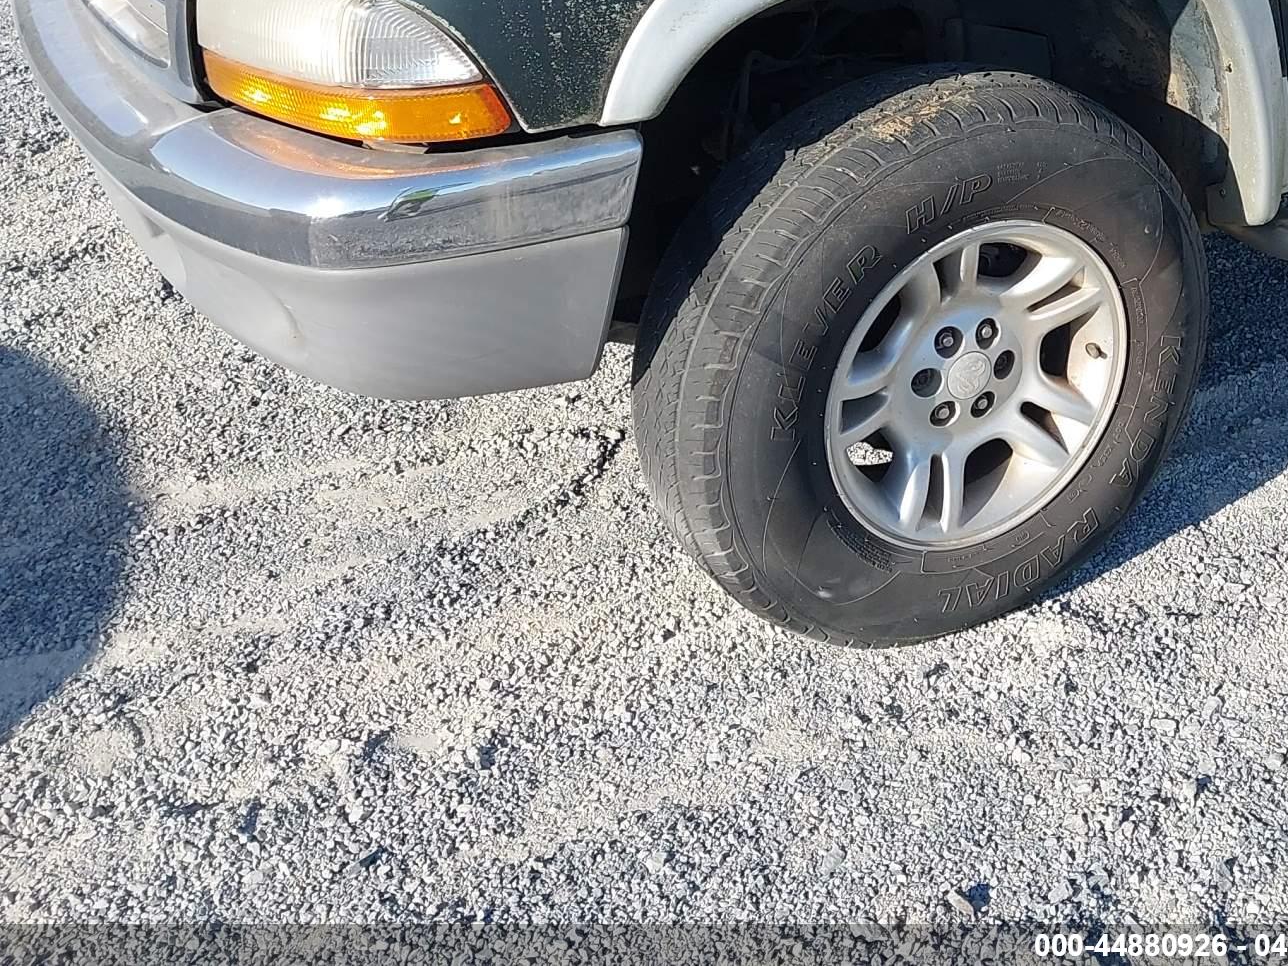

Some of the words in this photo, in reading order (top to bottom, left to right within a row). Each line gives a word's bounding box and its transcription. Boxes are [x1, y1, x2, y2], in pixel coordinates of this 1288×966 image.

[770, 245, 882, 441] KLEVER
[906, 174, 993, 234] H/P
[1109, 334, 1182, 488] KENDA
[938, 506, 1100, 614] RADIAL
